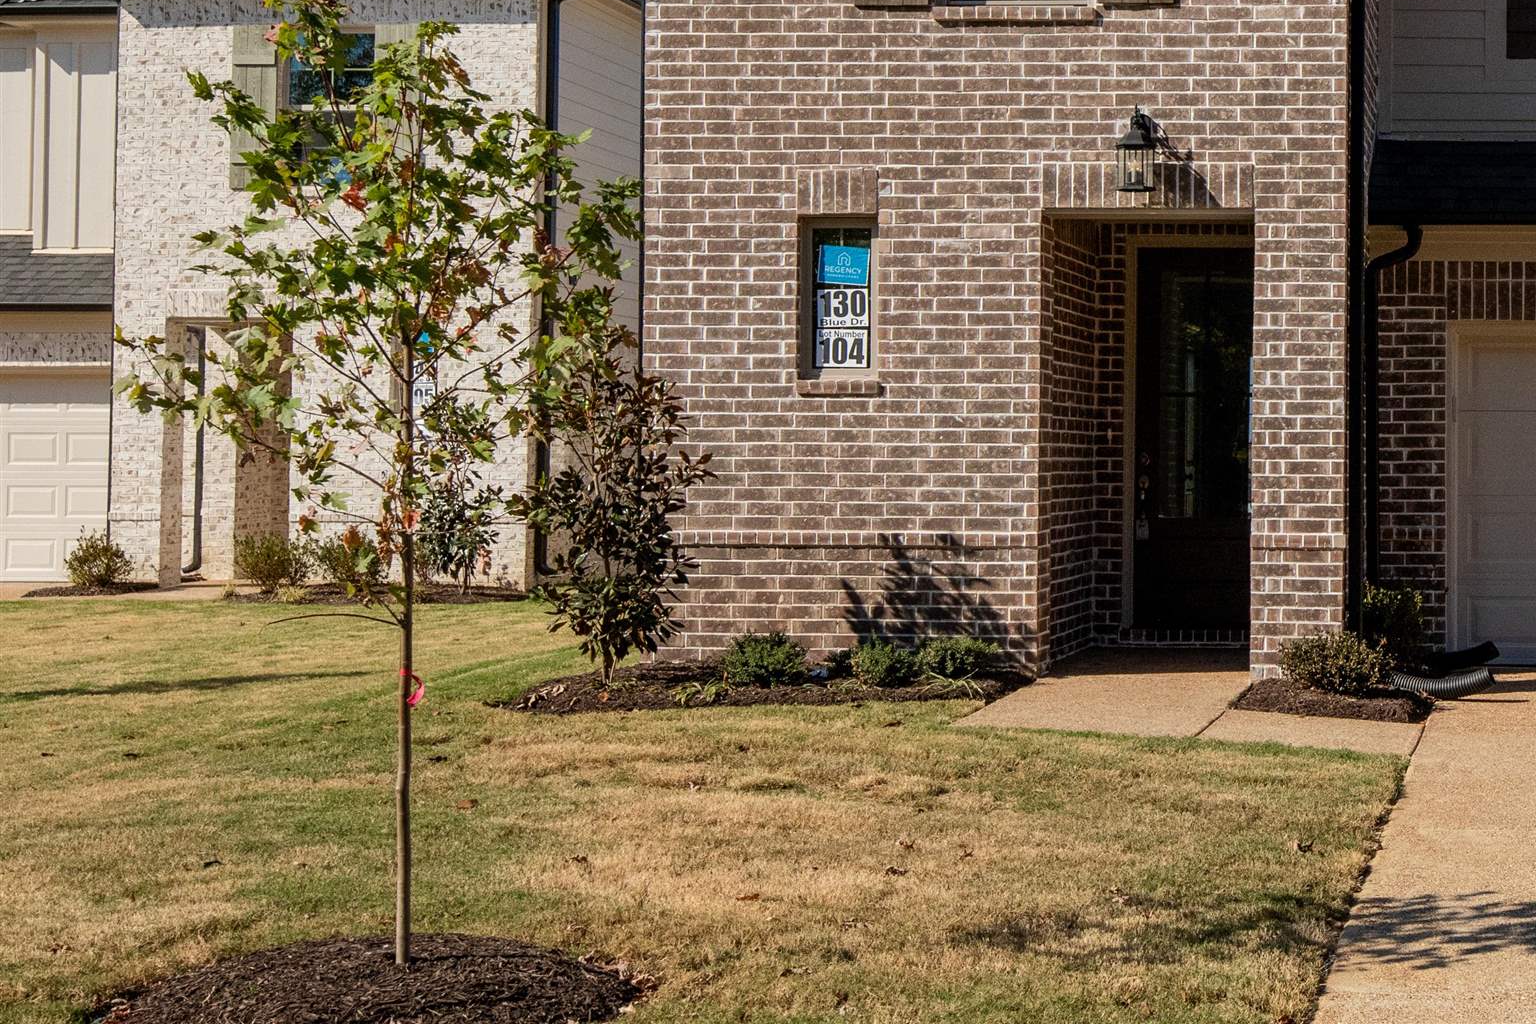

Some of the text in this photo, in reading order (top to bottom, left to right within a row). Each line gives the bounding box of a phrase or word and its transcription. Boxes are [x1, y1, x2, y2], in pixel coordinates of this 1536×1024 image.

[824, 265, 862, 275] REGENCY
[820, 290, 866, 318] 130
[820, 317, 867, 327] Blue Dr.
[818, 330, 865, 339] Lot Number
[819, 337, 865, 365] 104
[414, 388, 434, 405] 05
